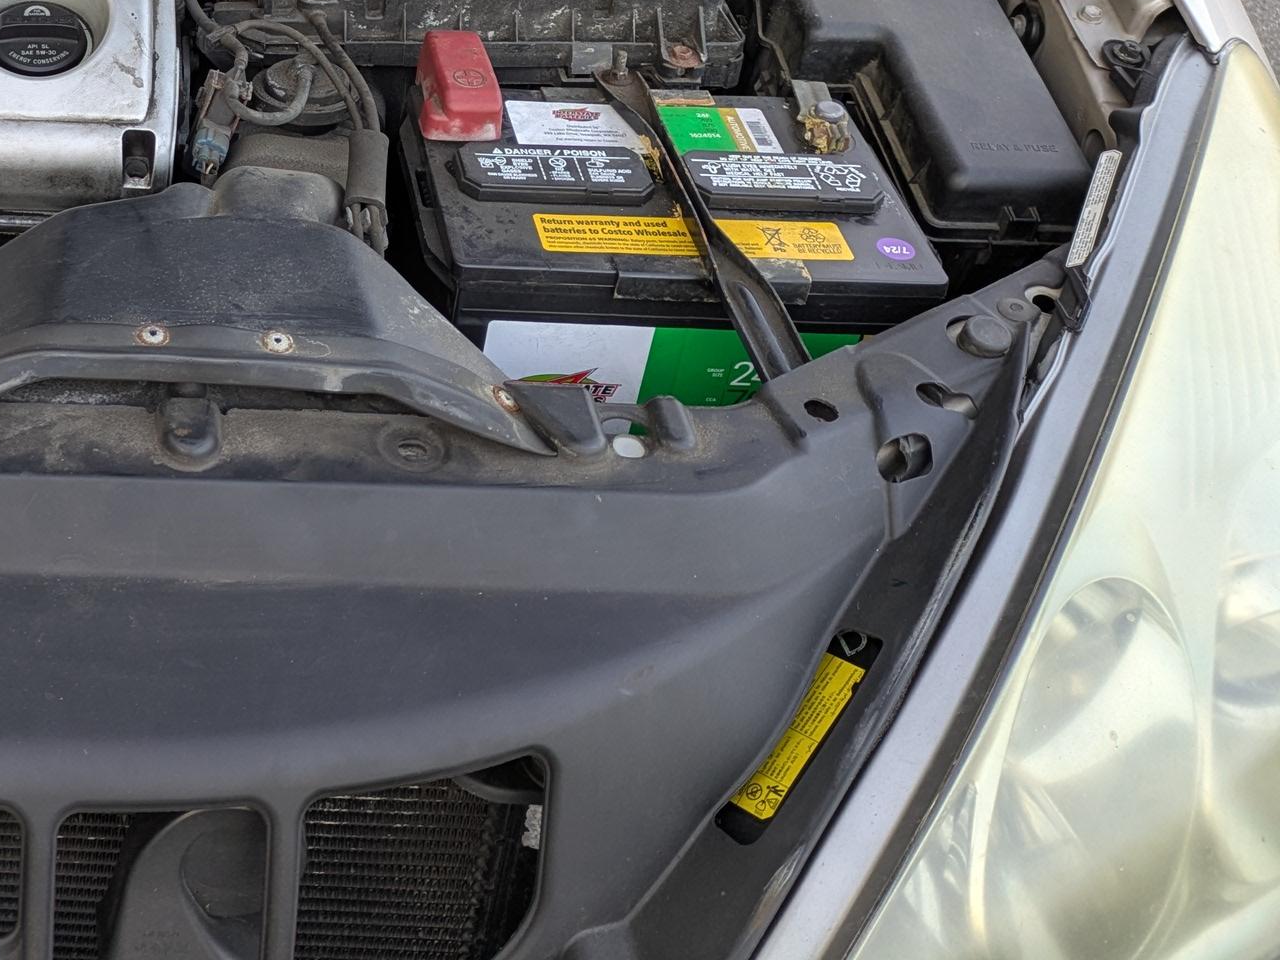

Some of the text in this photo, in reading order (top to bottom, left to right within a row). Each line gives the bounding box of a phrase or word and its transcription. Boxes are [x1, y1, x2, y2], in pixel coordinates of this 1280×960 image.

[8, 51, 70, 65] ENERGY CONSERVING
[504, 148, 552, 156] DANGER
[563, 149, 607, 157] POISON
[969, 142, 1010, 152] RELAY
[1023, 144, 1059, 153] FUSE
[540, 217, 668, 228] Return warranty and used
[543, 226, 587, 234] batteries
[601, 227, 632, 236] Costco
[633, 228, 687, 237] Wholesale
[883, 245, 910, 255] 7/24
